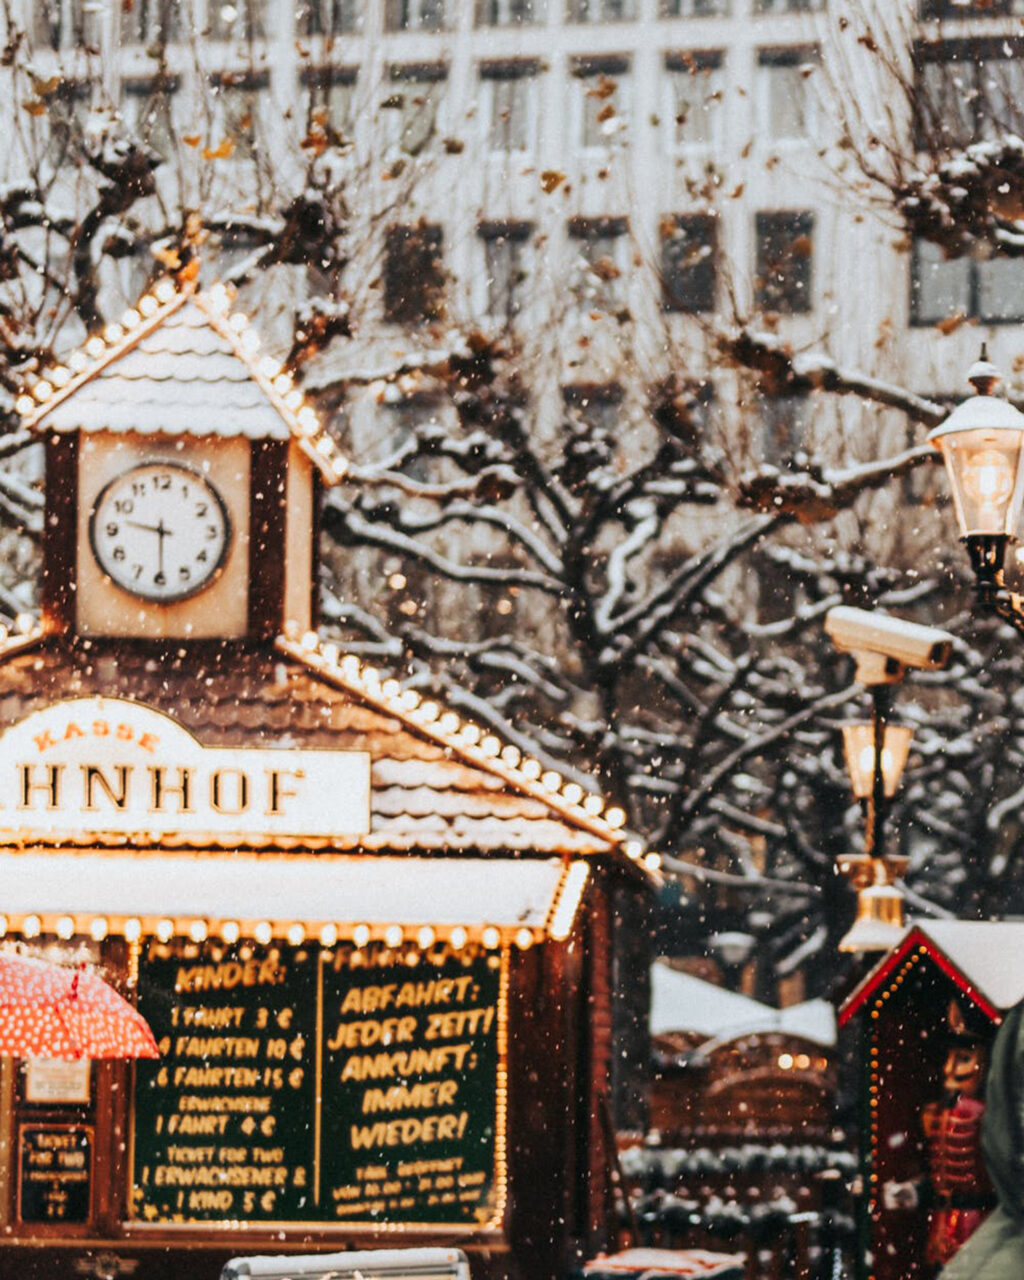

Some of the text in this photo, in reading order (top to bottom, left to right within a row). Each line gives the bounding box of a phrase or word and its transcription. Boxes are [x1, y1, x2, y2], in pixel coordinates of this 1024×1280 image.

[153, 474, 172, 491] 12
[114, 499, 134, 514] 10
[196, 502, 208, 518] 2
[106, 521, 119, 537] 9
[205, 524, 217, 540] 3
[196, 549, 207, 563] 4
[132, 564, 143, 580] 7
[32, 719, 161, 754] KASSE
[0, 762, 306, 816] HNHOF
[175, 958, 287, 993] KINDER:
[340, 975, 481, 1016] ABFAHRT:
[327, 1004, 495, 1051] JEDER ZEIT!
[175, 1036, 260, 1058] FAHRTEN
[266, 1037, 287, 1059] 10
[340, 1043, 478, 1082] ANKUNFT:
[174, 1066, 259, 1088] FAHRTEN
[361, 1079, 459, 1115] IMMER
[167, 1114, 230, 1136] FAHRT
[350, 1111, 469, 1150] WIEDER!
